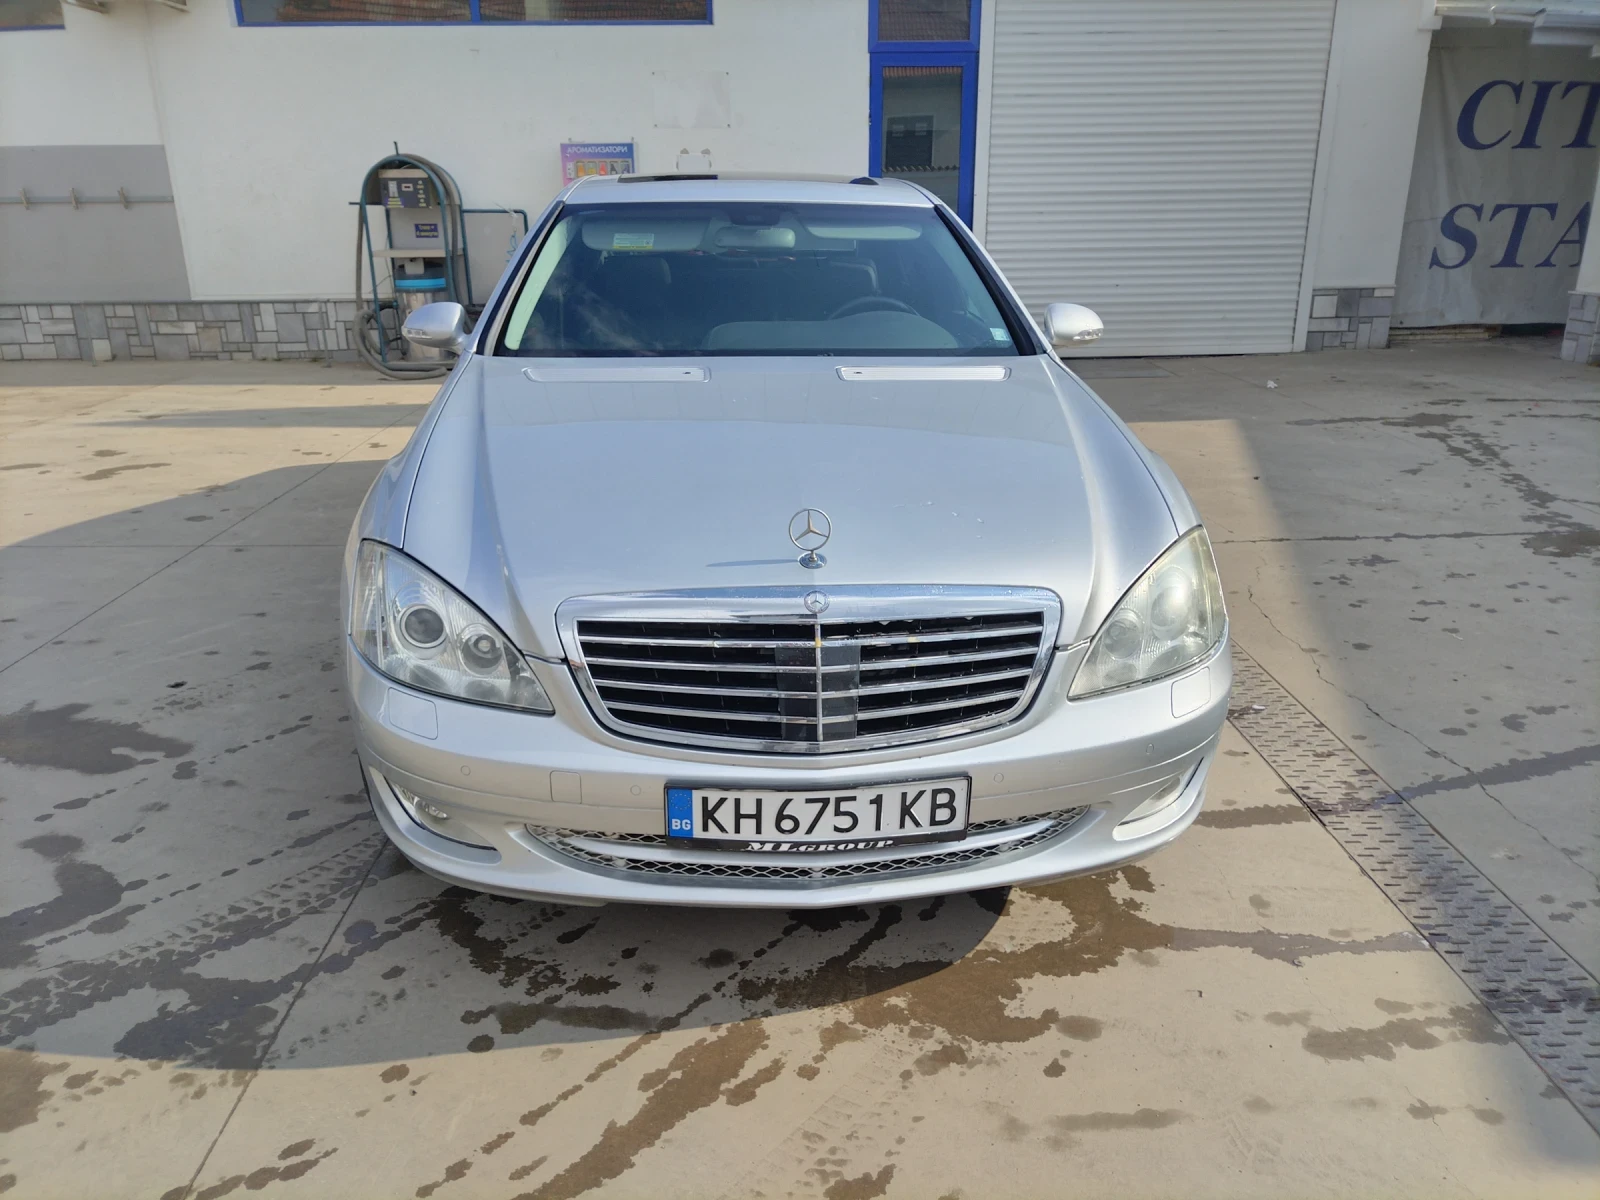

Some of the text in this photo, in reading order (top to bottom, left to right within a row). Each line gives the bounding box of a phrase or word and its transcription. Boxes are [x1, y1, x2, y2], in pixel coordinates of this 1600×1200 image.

[1456, 79, 1600, 150] CIT
[567, 145, 628, 154] АРОМАТИЗАТОРИ
[1429, 201, 1590, 270] STA
[671, 818, 692, 830] BG
